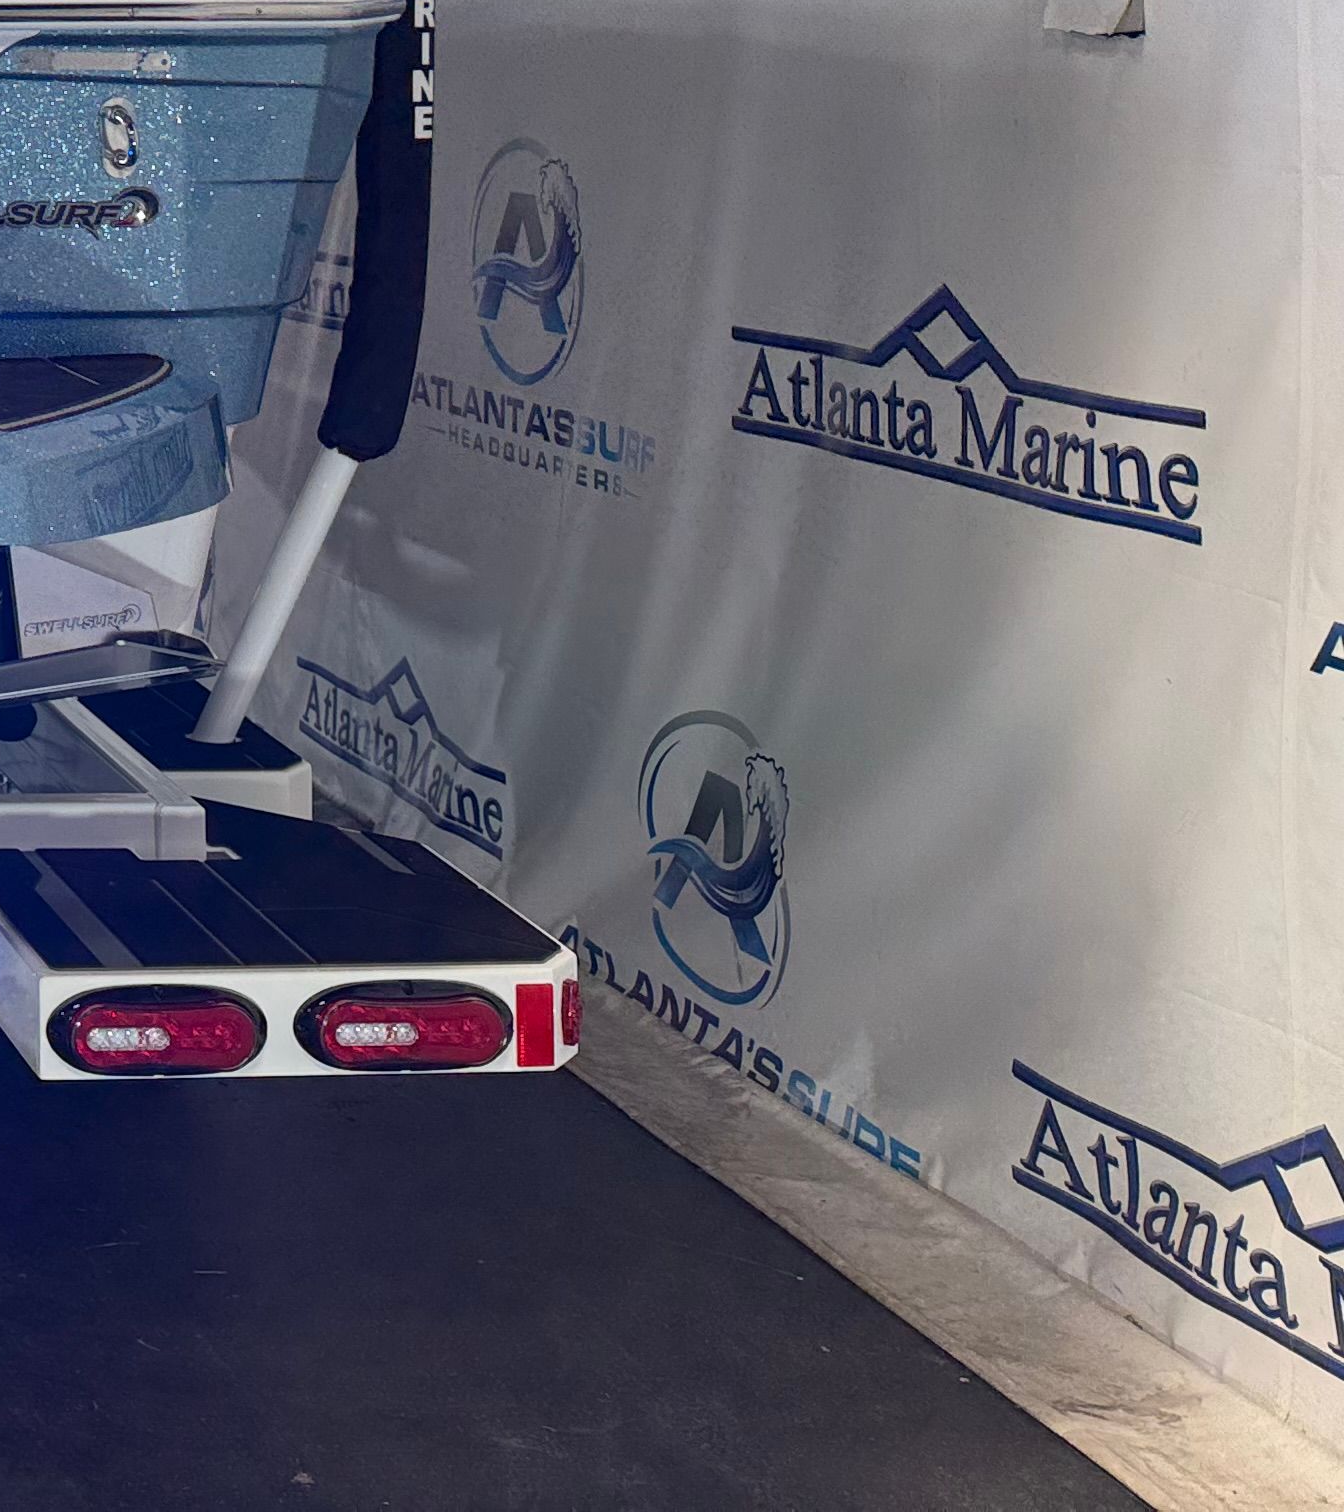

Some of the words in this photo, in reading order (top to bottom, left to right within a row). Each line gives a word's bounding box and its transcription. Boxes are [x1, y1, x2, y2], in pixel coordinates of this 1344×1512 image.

[411, 371, 576, 448] ATLANTA'S
[574, 415, 656, 474] SURF
[737, 343, 938, 461] Atlanta
[953, 381, 1202, 522] Marine
[23, 610, 132, 638] SWELLSURF
[302, 673, 400, 776] Atlanta
[399, 728, 505, 843] Marine
[558, 924, 784, 1095] ATLANTA'S
[1019, 1097, 1300, 1330] Atlanta
